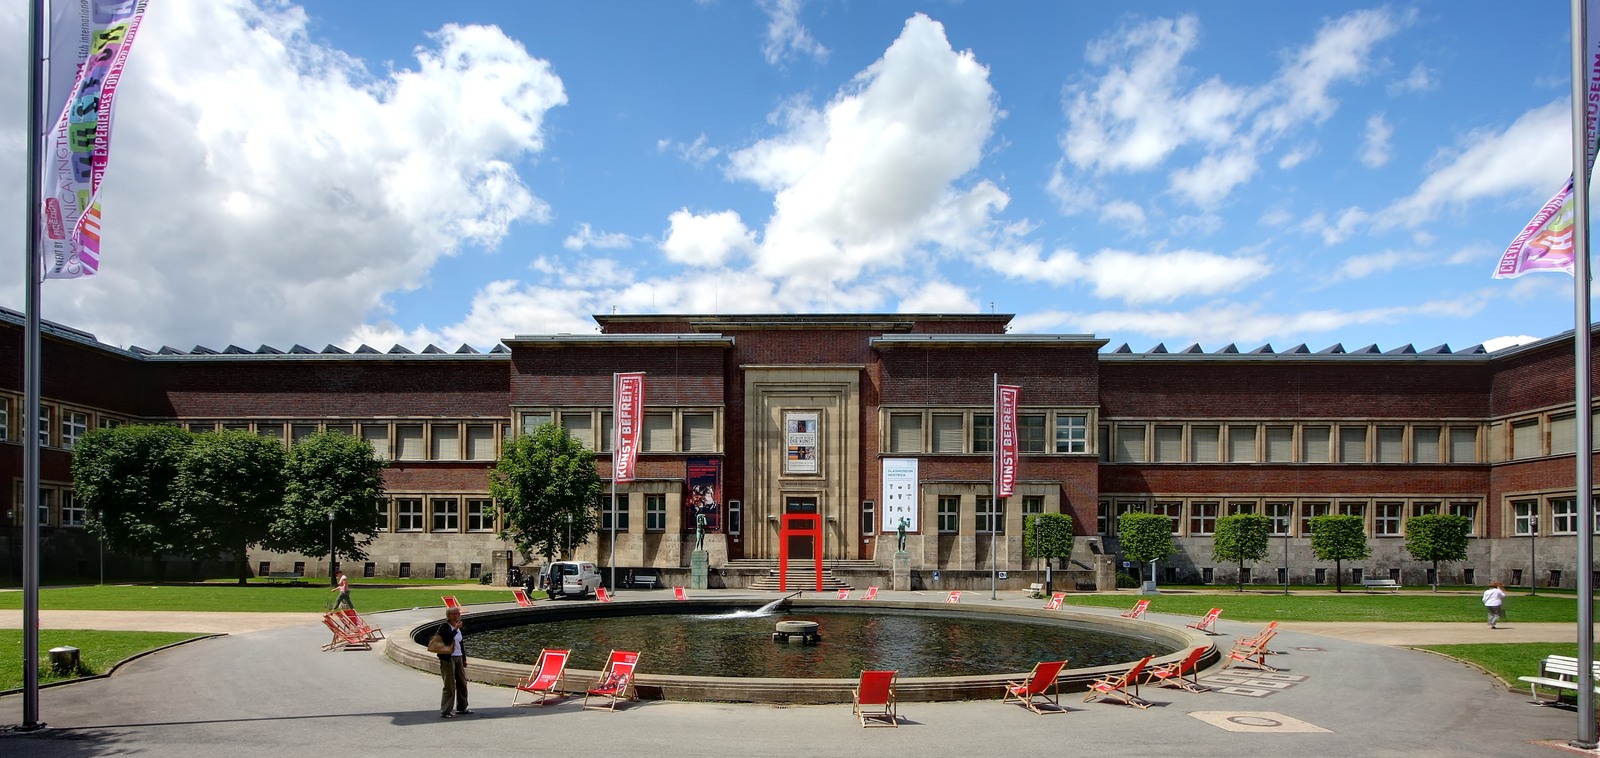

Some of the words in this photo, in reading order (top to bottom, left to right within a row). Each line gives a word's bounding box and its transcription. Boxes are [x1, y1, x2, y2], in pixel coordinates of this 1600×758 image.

[104, 73, 120, 90] FOR
[95, 92, 113, 156] EXPERIENCES
[94, 161, 107, 192] TIPLE
[54, 241, 63, 249] BY
[54, 249, 64, 267] EVENT
[621, 379, 633, 435] BEFREIT!
[1003, 391, 1013, 446] BEFREIT!
[618, 437, 632, 478] KUNST
[1003, 450, 1013, 492] KUNST
